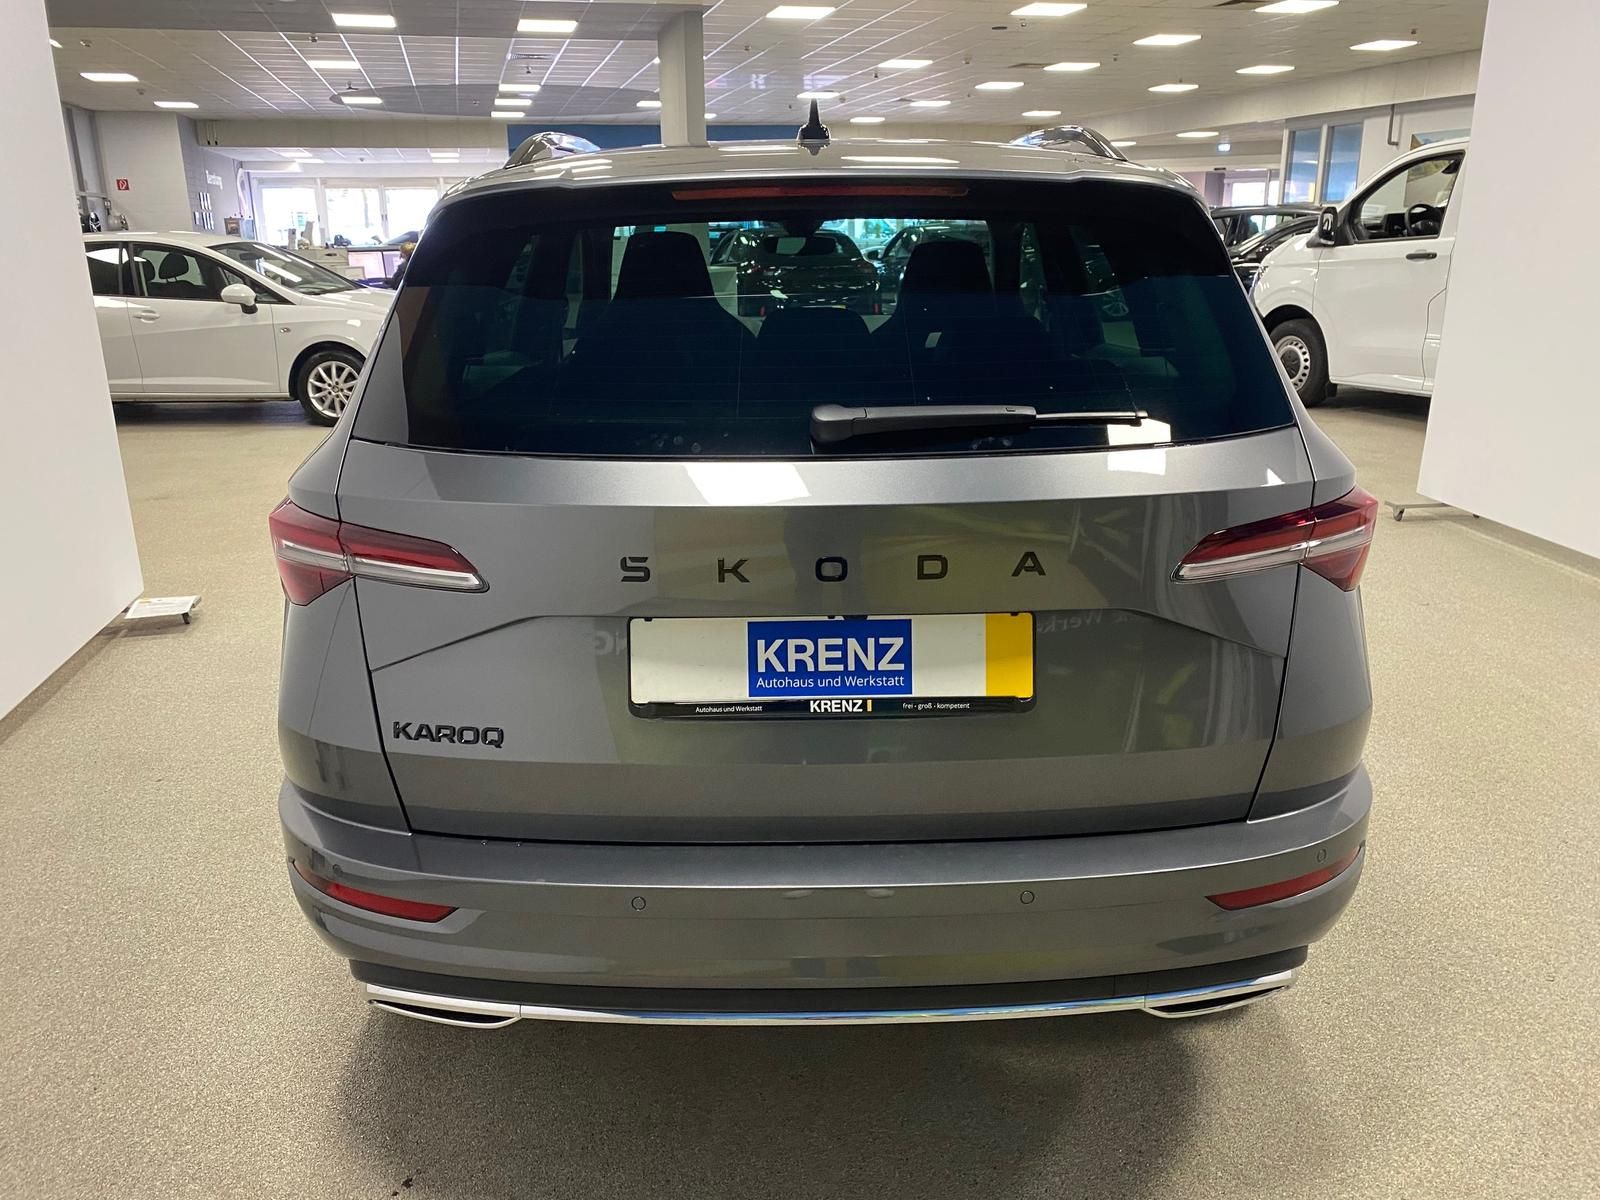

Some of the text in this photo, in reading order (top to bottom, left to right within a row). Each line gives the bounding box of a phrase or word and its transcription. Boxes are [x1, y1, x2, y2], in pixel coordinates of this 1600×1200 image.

[757, 637, 905, 673] KRENZ
[756, 675, 905, 688] Autohaus und Werkstatt
[696, 705, 722, 713] Autohaus
[723, 705, 734, 713] und
[810, 700, 863, 713] KRENZ
[393, 721, 504, 749] KAROQ
